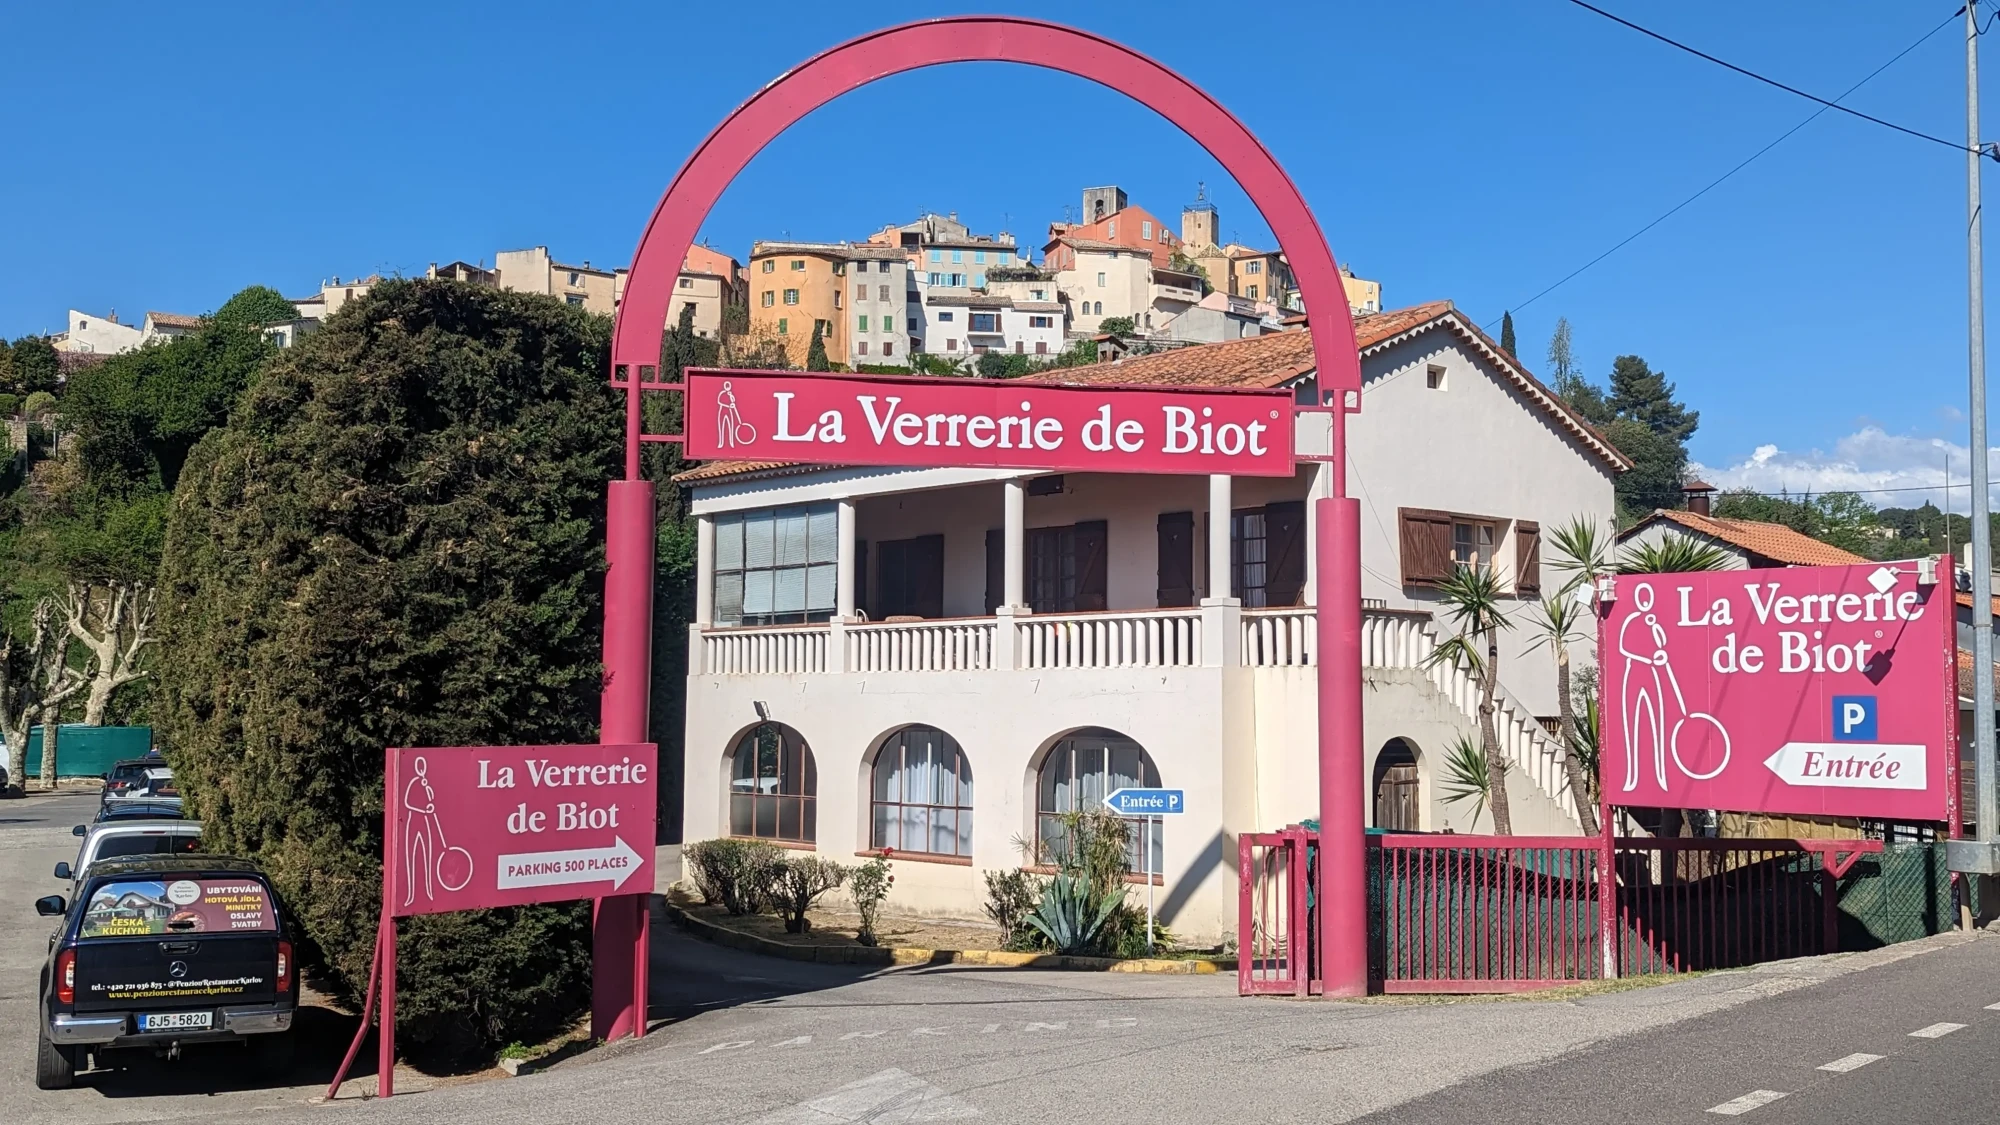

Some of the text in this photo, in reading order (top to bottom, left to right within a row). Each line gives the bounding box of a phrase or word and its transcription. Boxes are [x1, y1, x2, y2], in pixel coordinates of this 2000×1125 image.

[772, 392, 846, 444] La
[856, 395, 1063, 450] Verrerie
[1081, 403, 1145, 452] de
[1676, 583, 1925, 627] La Verrerie
[1712, 633, 1764, 674] de
[1843, 703, 1865, 734] P
[477, 757, 648, 789] La Verrerie
[1800, 751, 1902, 780] Entrée
[1120, 794, 1179, 808] Entrée P
[506, 801, 619, 834] de Biot
[508, 856, 628, 877] PARKING 500 PLACES
[206, 884, 262, 894] UBYTOVÁNÍ
[204, 895, 262, 904] HOTOVÁ JÍDLA
[111, 916, 144, 926] ČESKÁ
[230, 912, 262, 920] OSLAVY
[102, 925, 151, 935] KUCHYNĚ
[136, 982, 150, 990] 936
[148, 1013, 207, 1027] 6J5 5820
